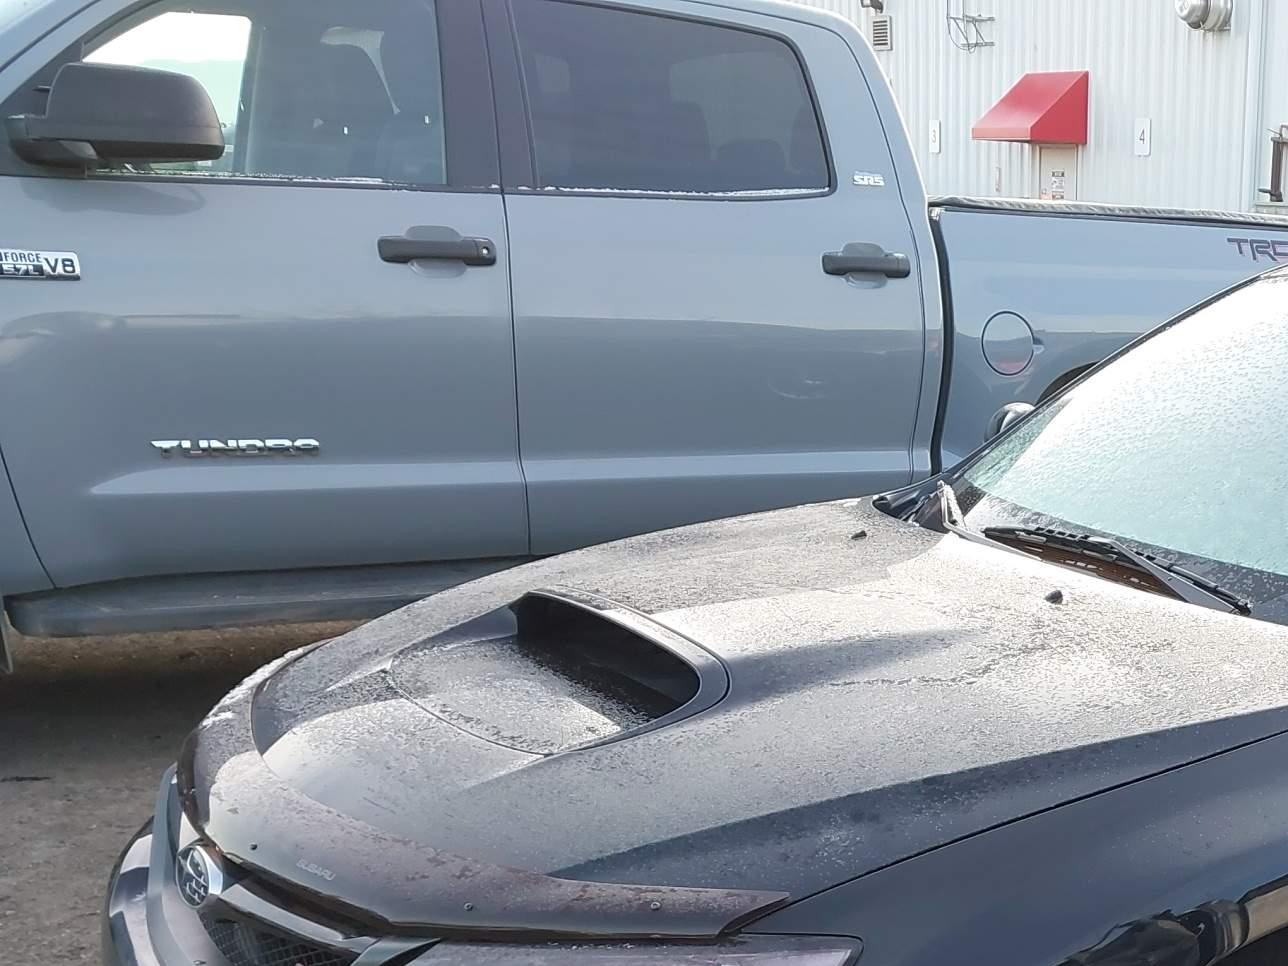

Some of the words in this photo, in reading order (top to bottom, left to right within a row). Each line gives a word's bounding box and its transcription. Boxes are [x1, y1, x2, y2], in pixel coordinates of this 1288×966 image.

[1138, 127, 1145, 145] 4
[44, 258, 76, 274] V8
[150, 438, 320, 458] TUNDRA
[295, 859, 337, 881] SUBARU
